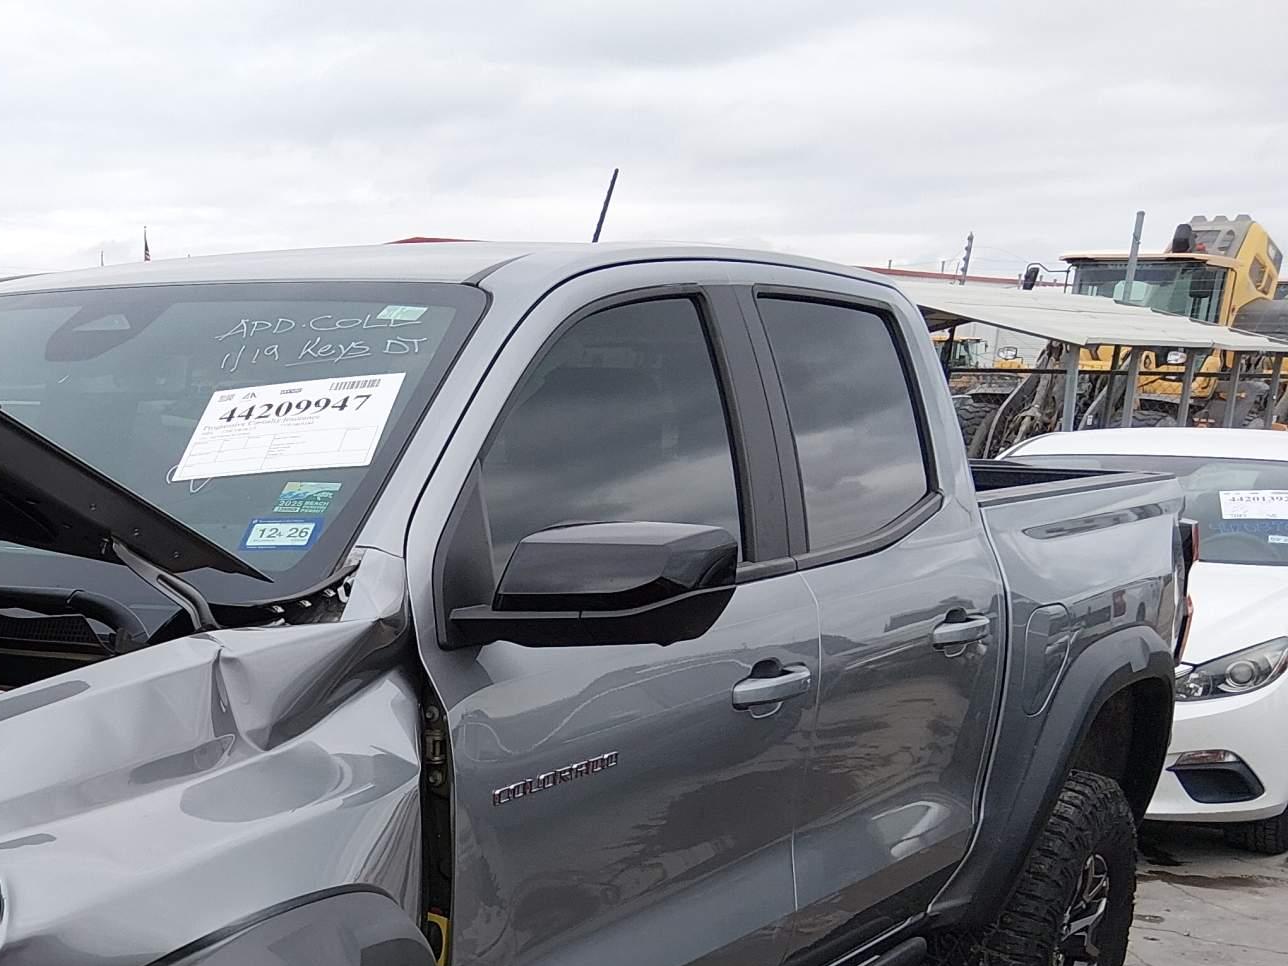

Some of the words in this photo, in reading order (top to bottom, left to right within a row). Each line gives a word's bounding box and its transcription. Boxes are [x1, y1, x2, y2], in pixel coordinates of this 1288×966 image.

[219, 394, 373, 423] 44209947
[259, 527, 279, 538] 12
[286, 527, 309, 538] 26
[493, 751, 619, 806] COLORADO
